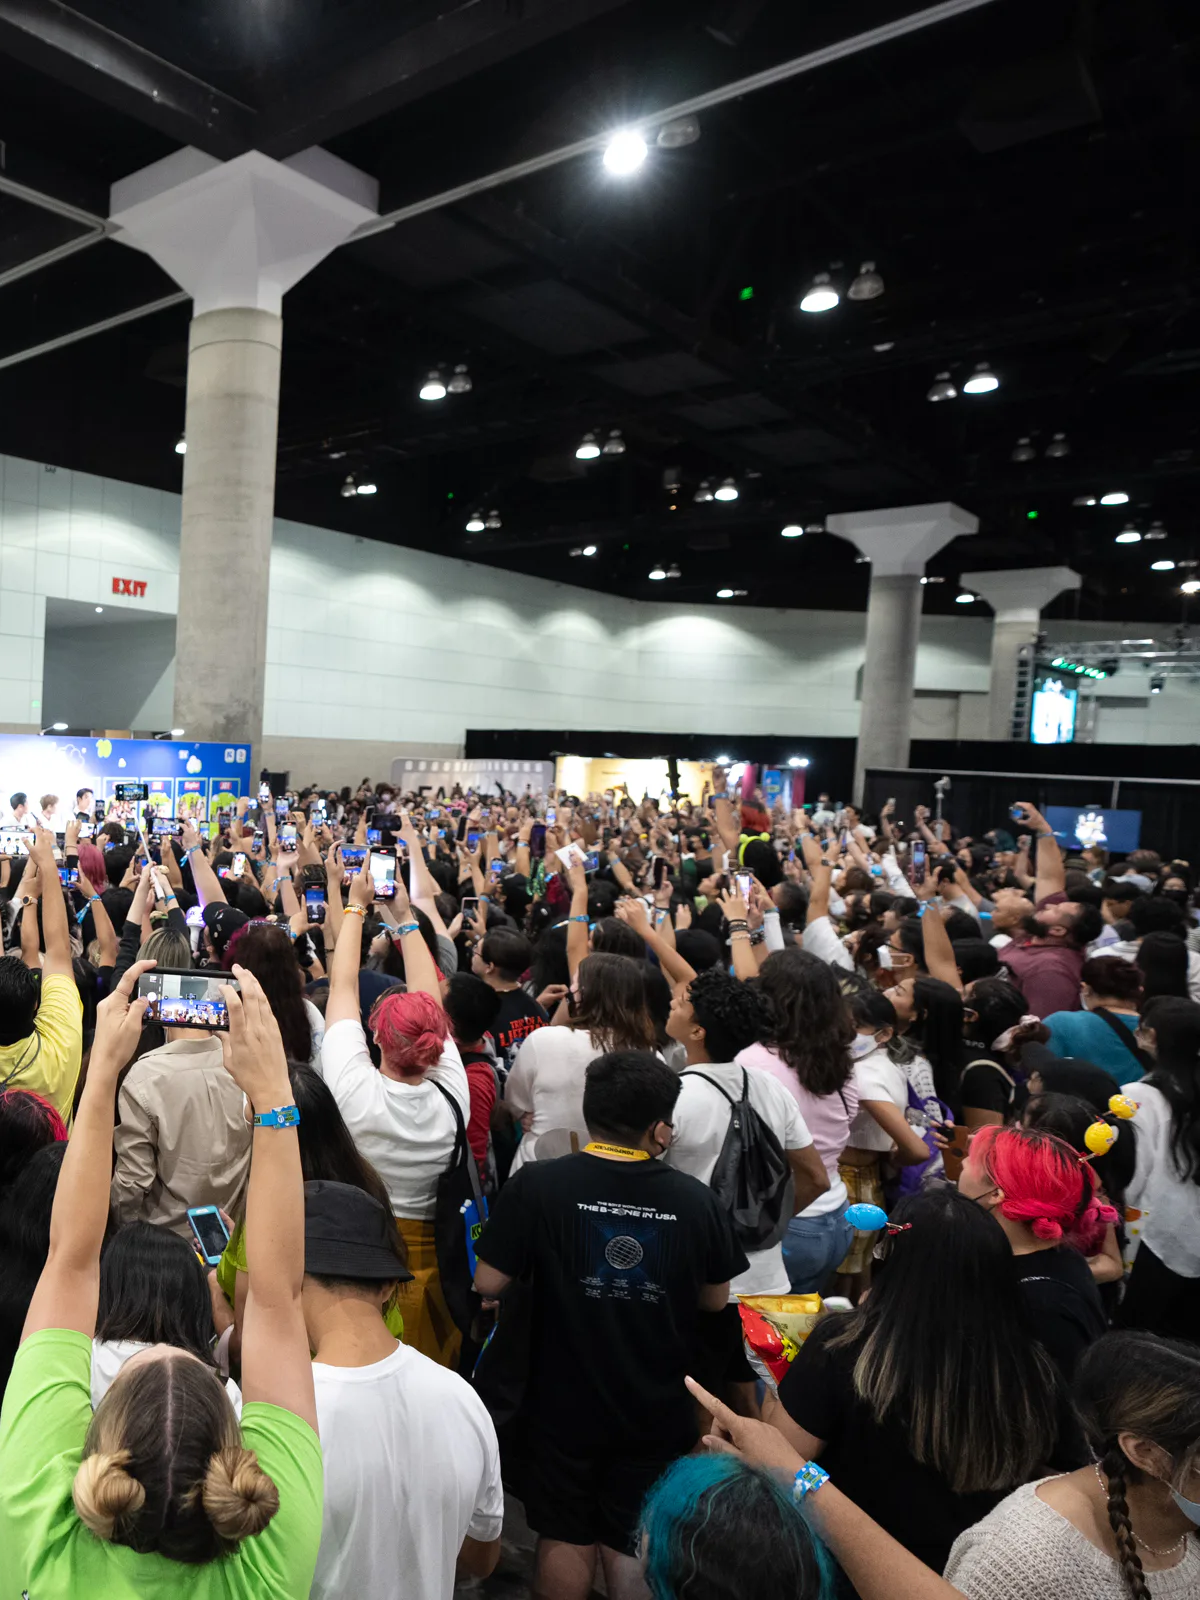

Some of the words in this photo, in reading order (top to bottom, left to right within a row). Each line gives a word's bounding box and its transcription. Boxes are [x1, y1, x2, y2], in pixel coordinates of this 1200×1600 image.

[112, 577, 147, 597] EXIT
[642, 1211, 653, 1219] IN
[655, 1213, 677, 1221] USA
